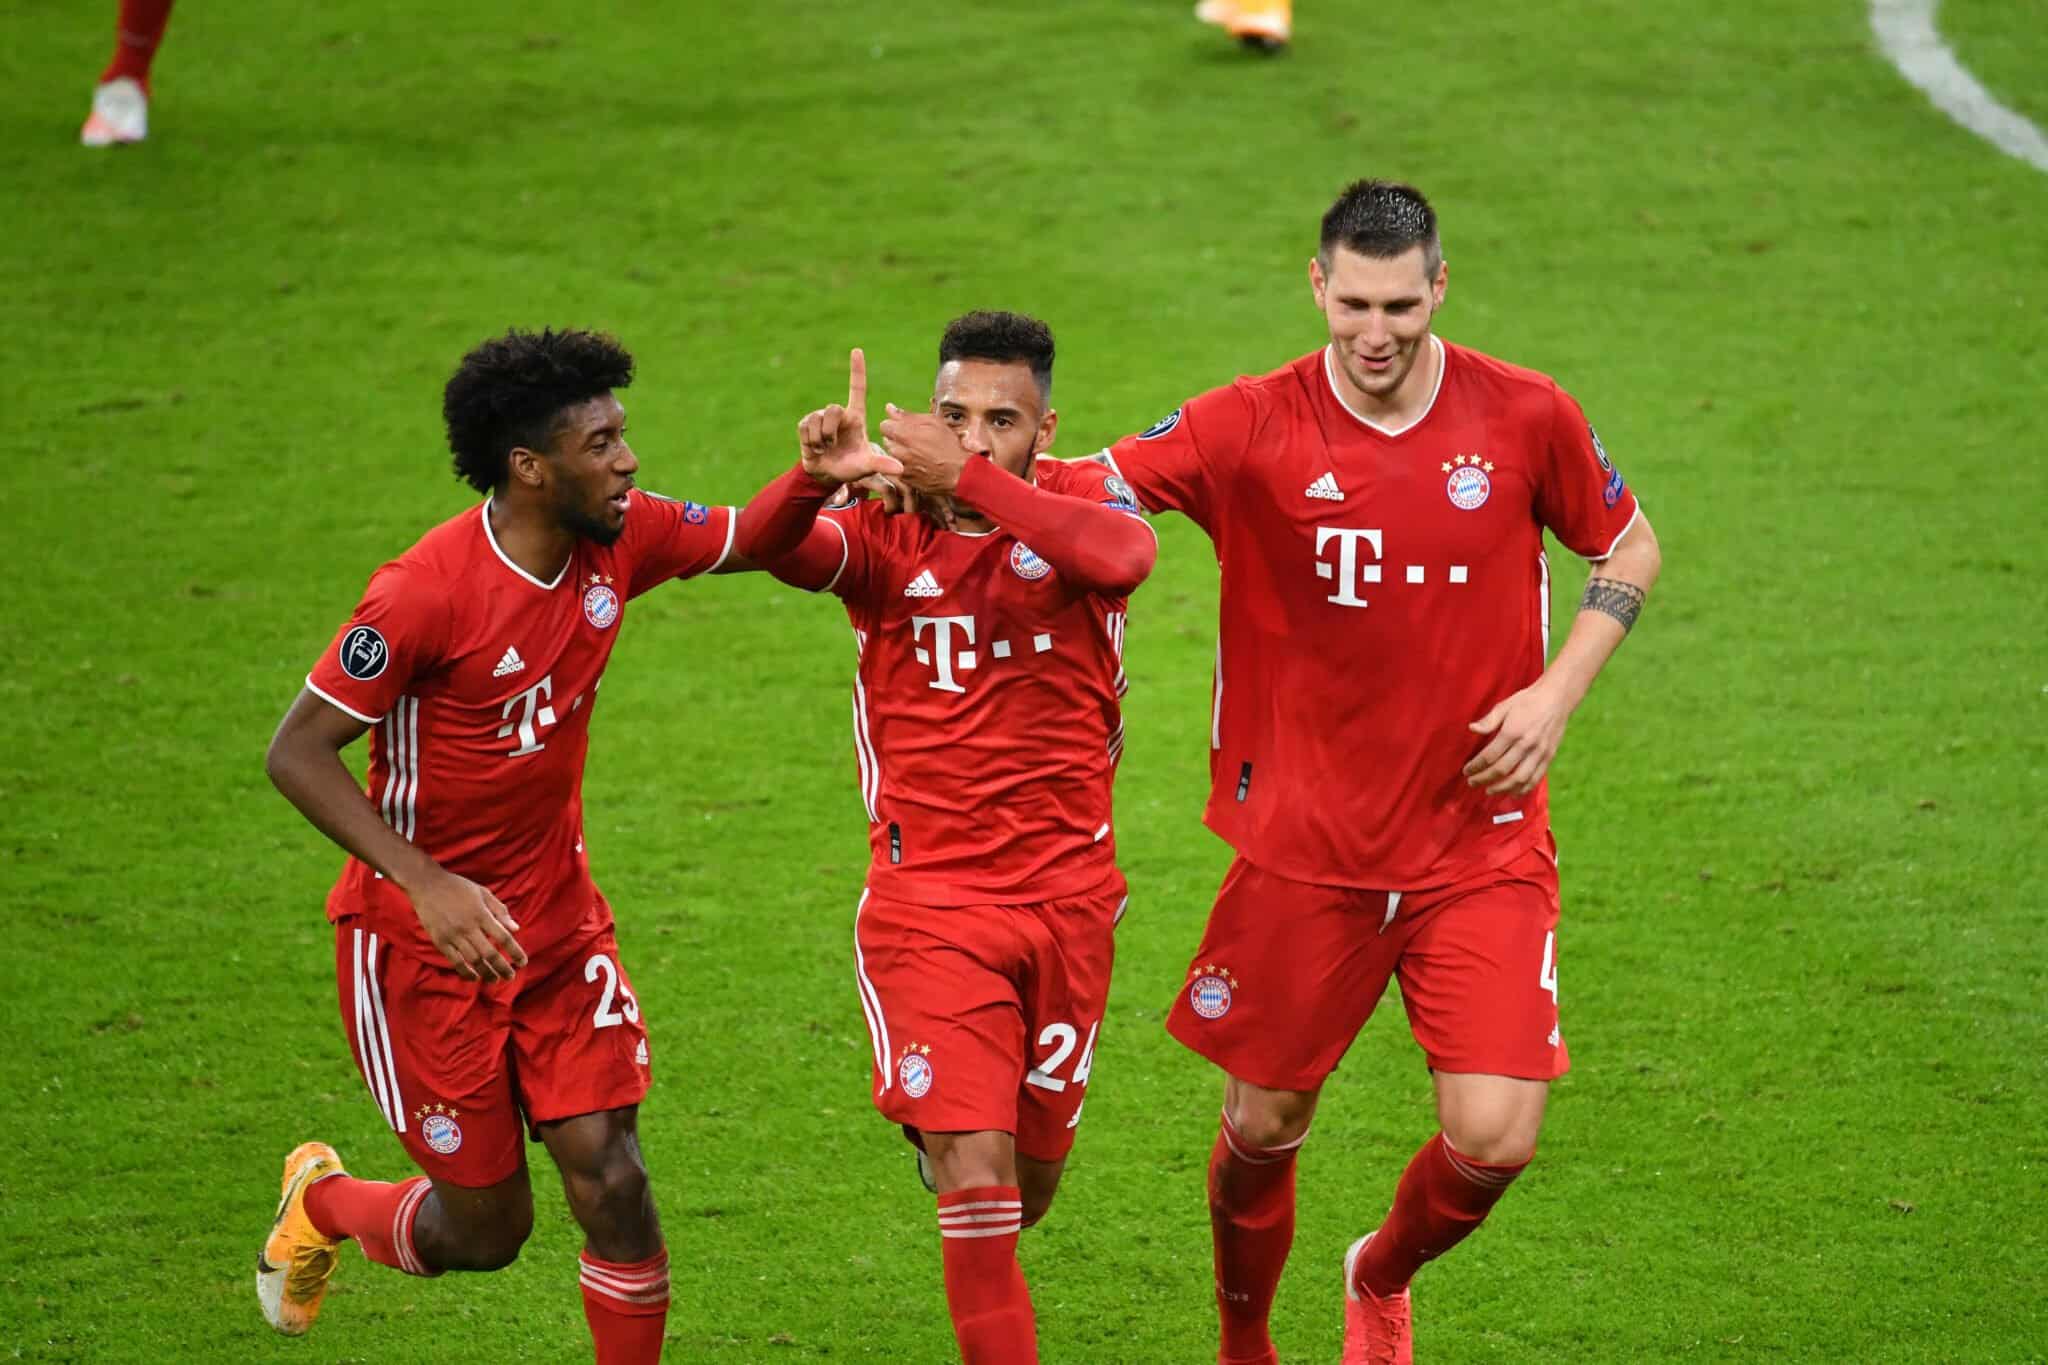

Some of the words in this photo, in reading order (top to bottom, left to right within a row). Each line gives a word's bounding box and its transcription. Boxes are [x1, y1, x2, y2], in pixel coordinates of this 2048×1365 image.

[1305, 488, 1345, 501] adidas
[904, 586, 944, 598] adidas
[1026, 1020, 1098, 1092] 24
